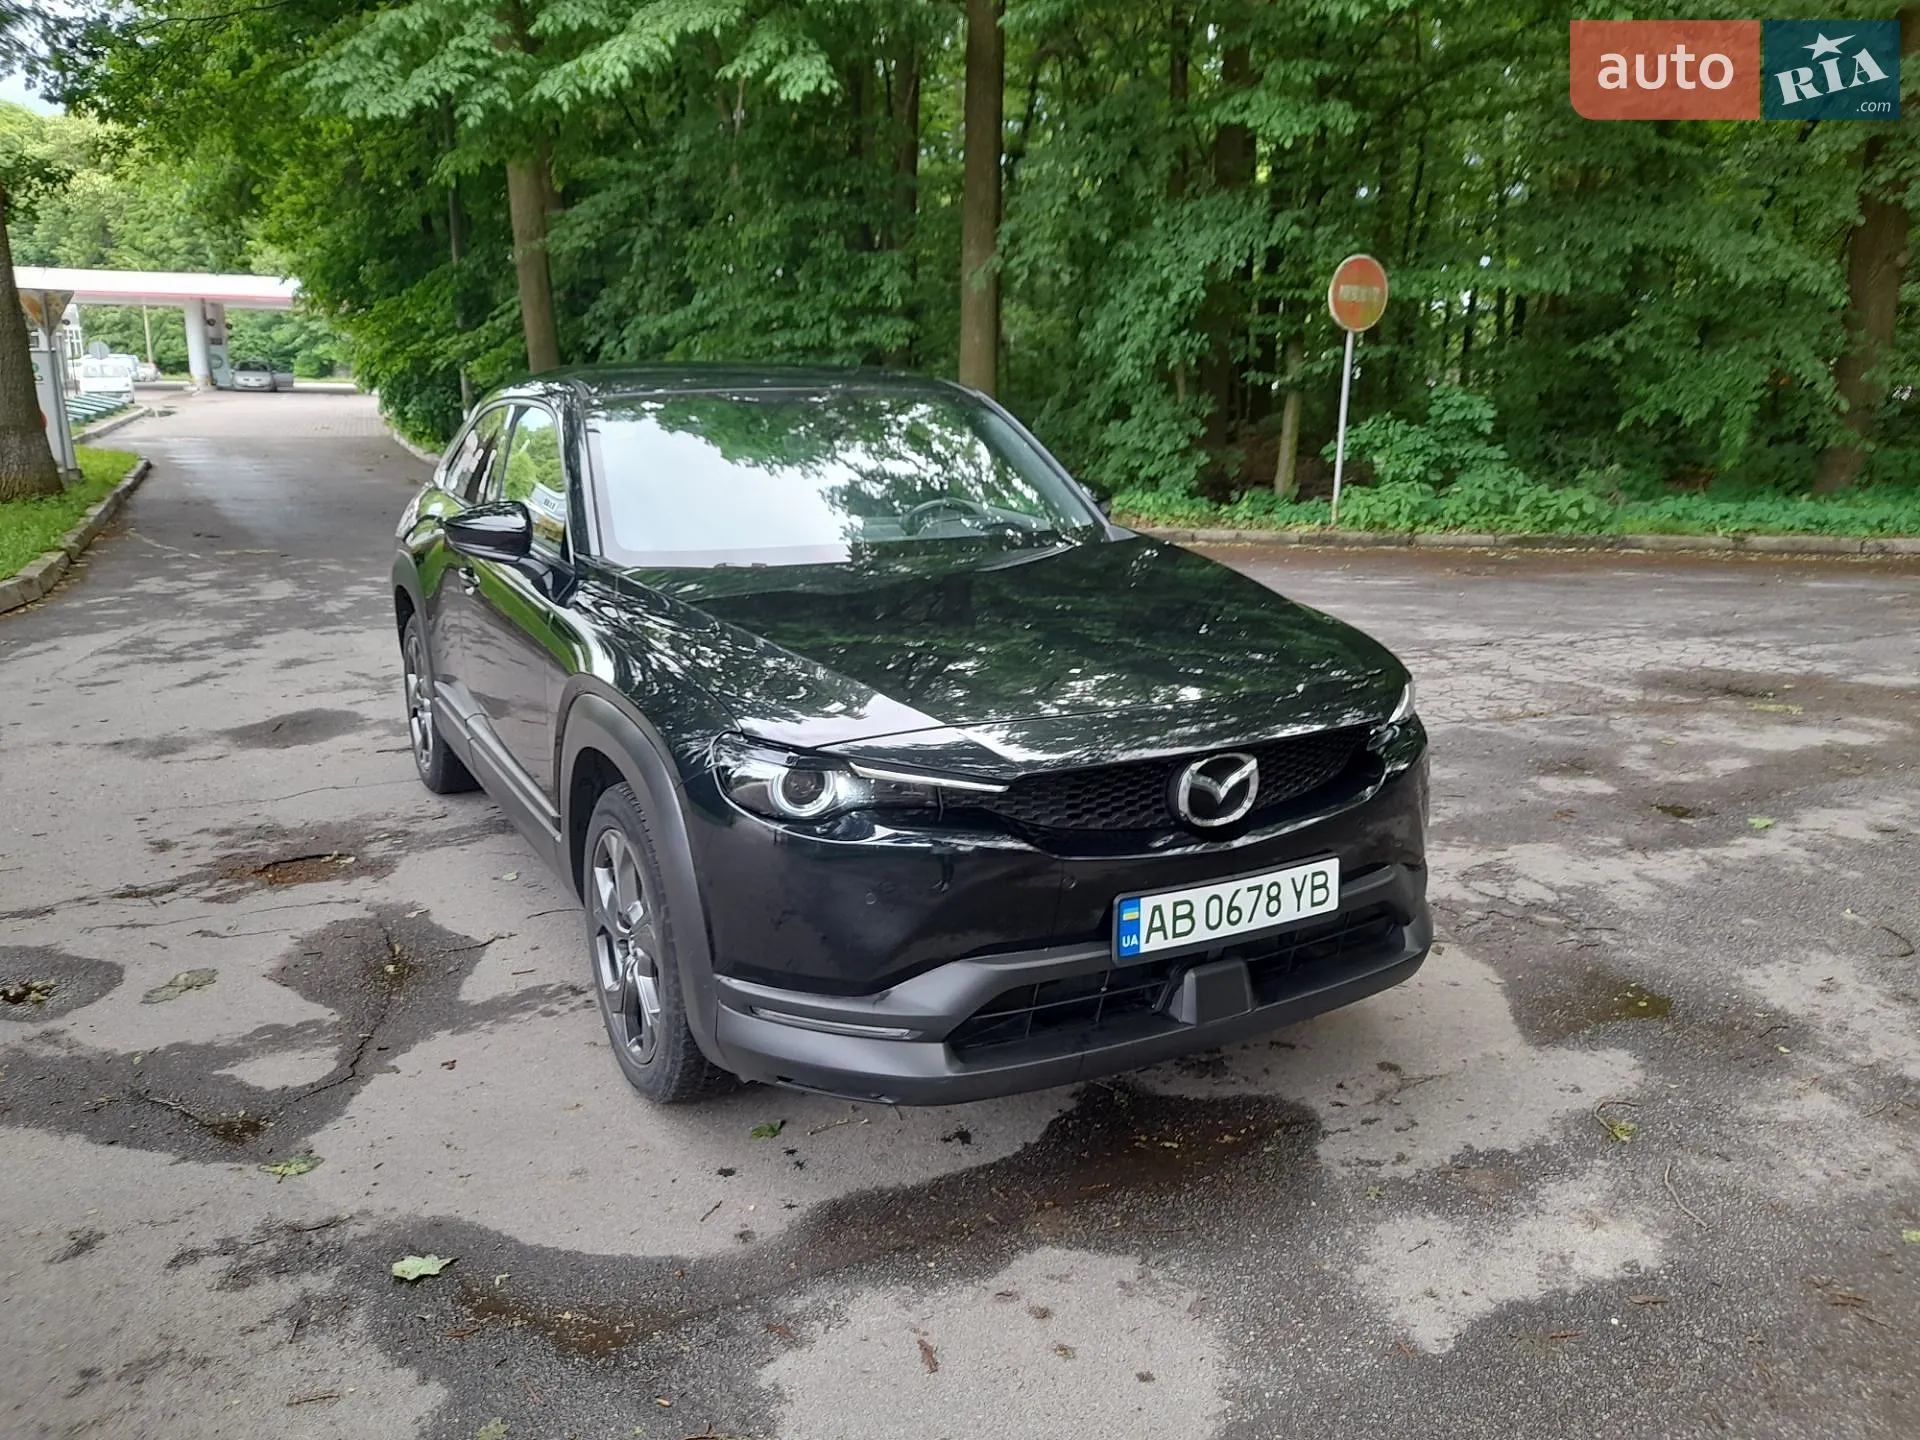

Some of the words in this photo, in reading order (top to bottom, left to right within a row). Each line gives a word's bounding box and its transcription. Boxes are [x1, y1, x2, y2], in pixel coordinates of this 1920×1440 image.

[1144, 899, 1196, 944] AB
[1205, 881, 1282, 931] 0678
[1291, 870, 1330, 912] YB
[1122, 933, 1138, 948] UA
